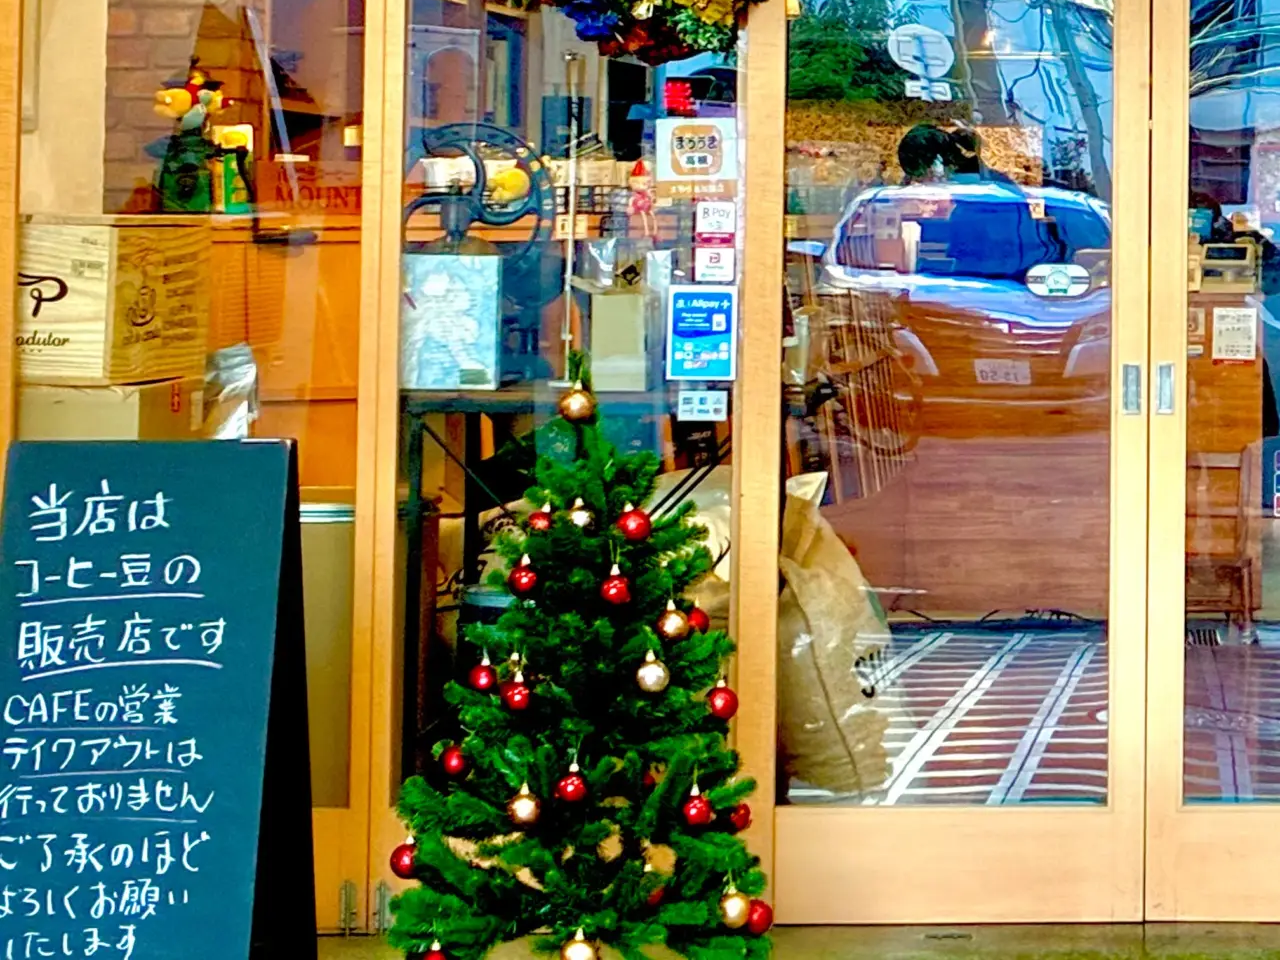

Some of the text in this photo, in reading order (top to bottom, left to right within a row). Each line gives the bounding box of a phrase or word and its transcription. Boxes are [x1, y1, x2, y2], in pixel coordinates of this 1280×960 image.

[28, 478, 174, 542] 当店は
[14, 553, 202, 597] コーヒー豆の
[17, 611, 227, 670] 販売店です
[3, 682, 184, 726] CAFEの営業
[3, 734, 204, 771] テイクアウトは
[0, 777, 215, 819] 行っておりません
[0, 831, 211, 875] ご了承のほど
[0, 878, 189, 920] よろしくお願い
